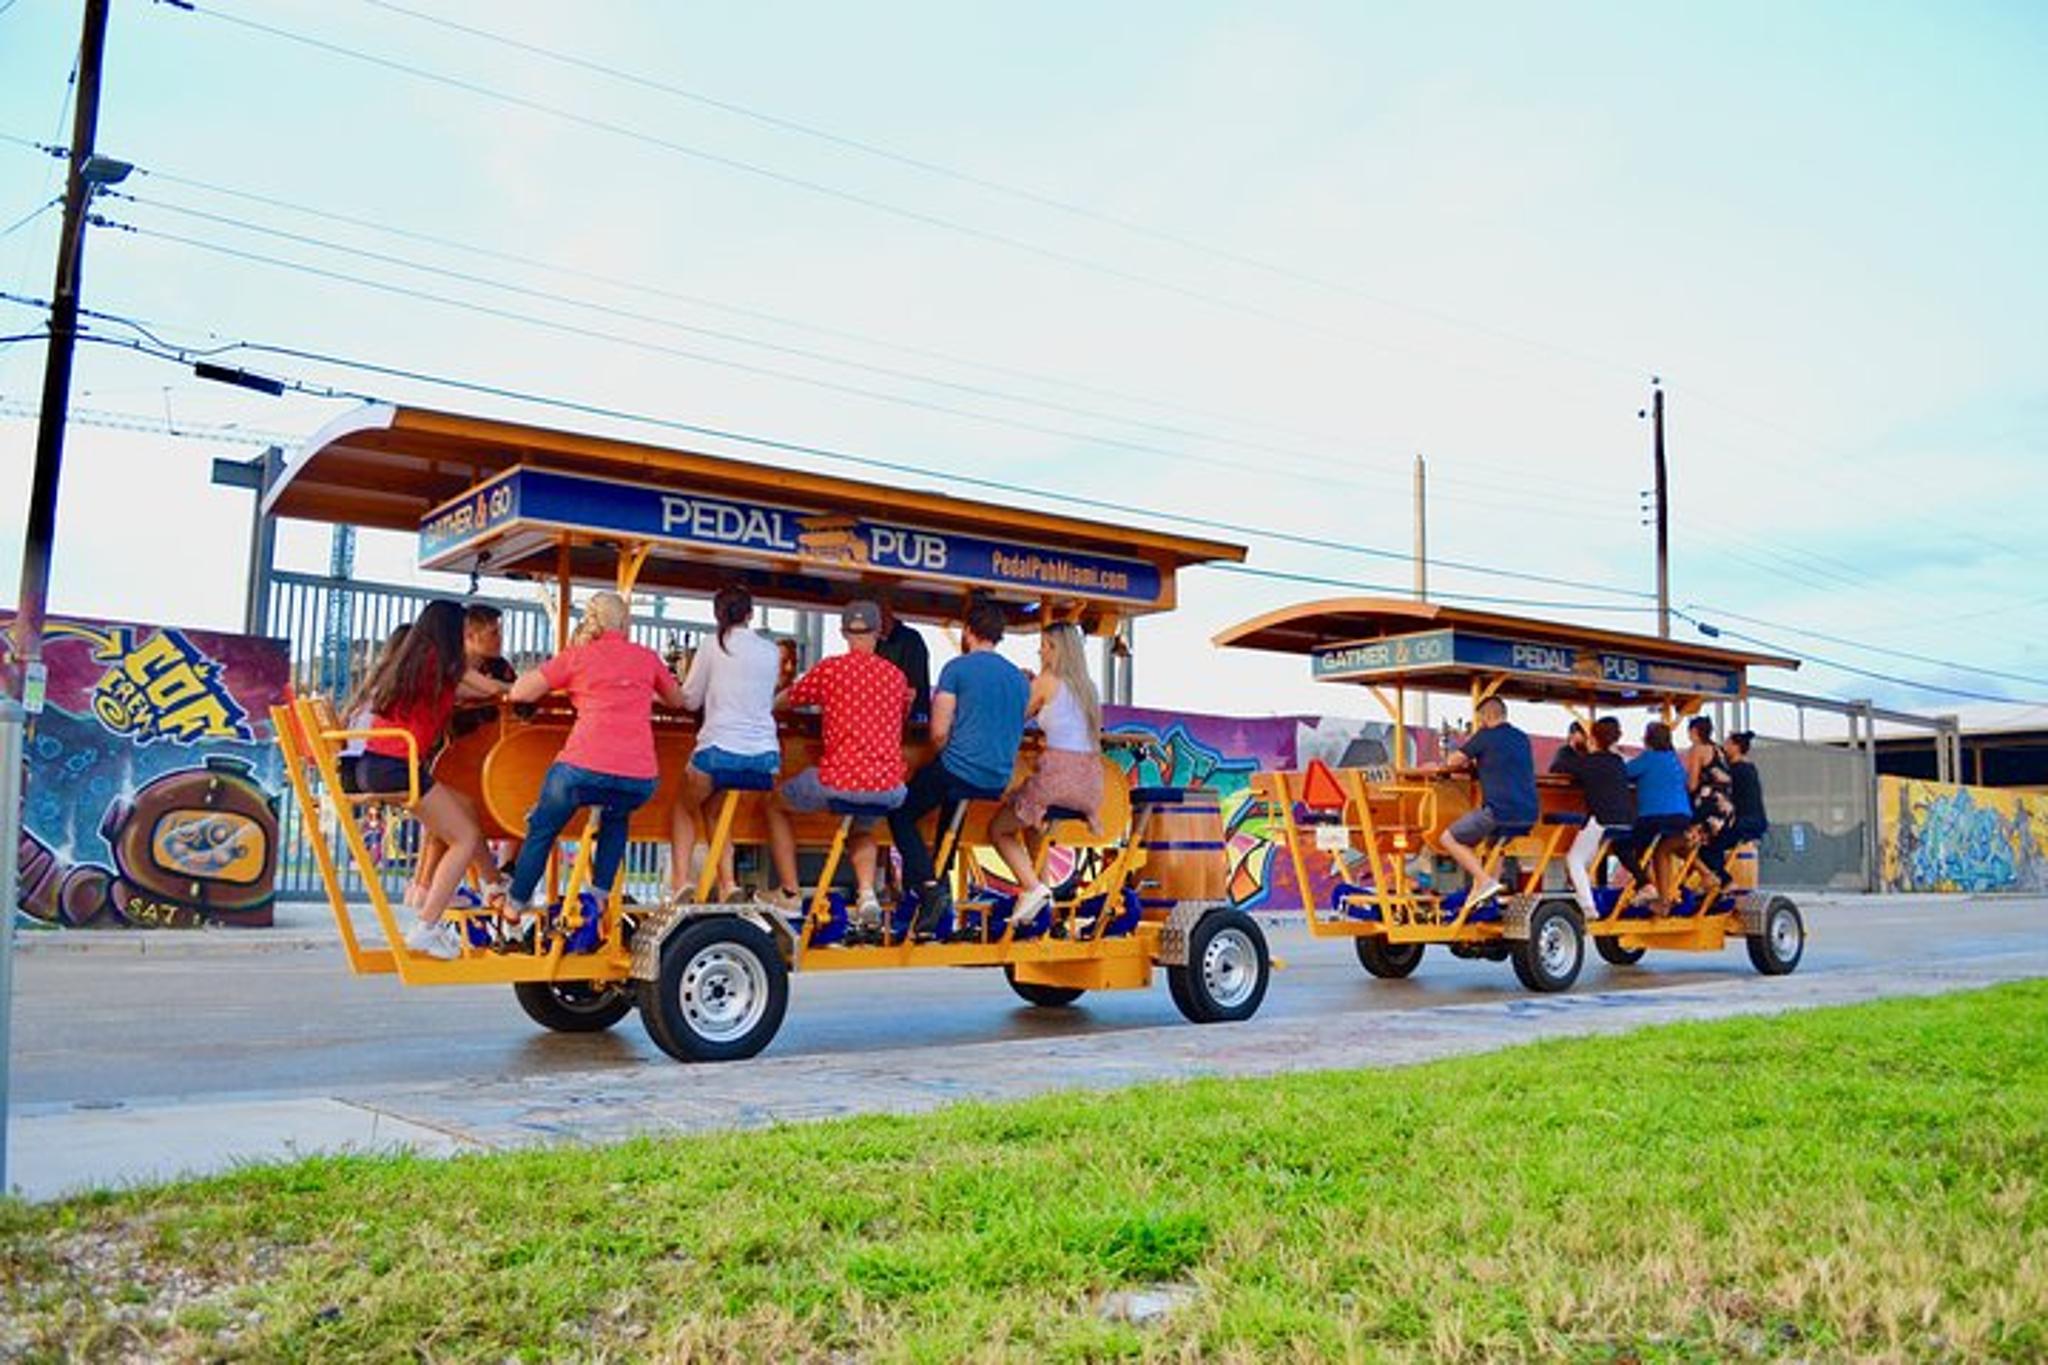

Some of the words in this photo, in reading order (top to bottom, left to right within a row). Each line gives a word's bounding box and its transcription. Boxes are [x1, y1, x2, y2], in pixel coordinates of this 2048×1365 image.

[661, 496, 796, 550] PEDAL
[870, 527, 947, 569] PUB
[992, 549, 1128, 591] PedalPubMiami.com
[1322, 645, 1390, 668] GATHER
[1417, 639, 1442, 659] GO
[1512, 645, 1571, 672] PEDAL
[1603, 657, 1639, 680] PUB
